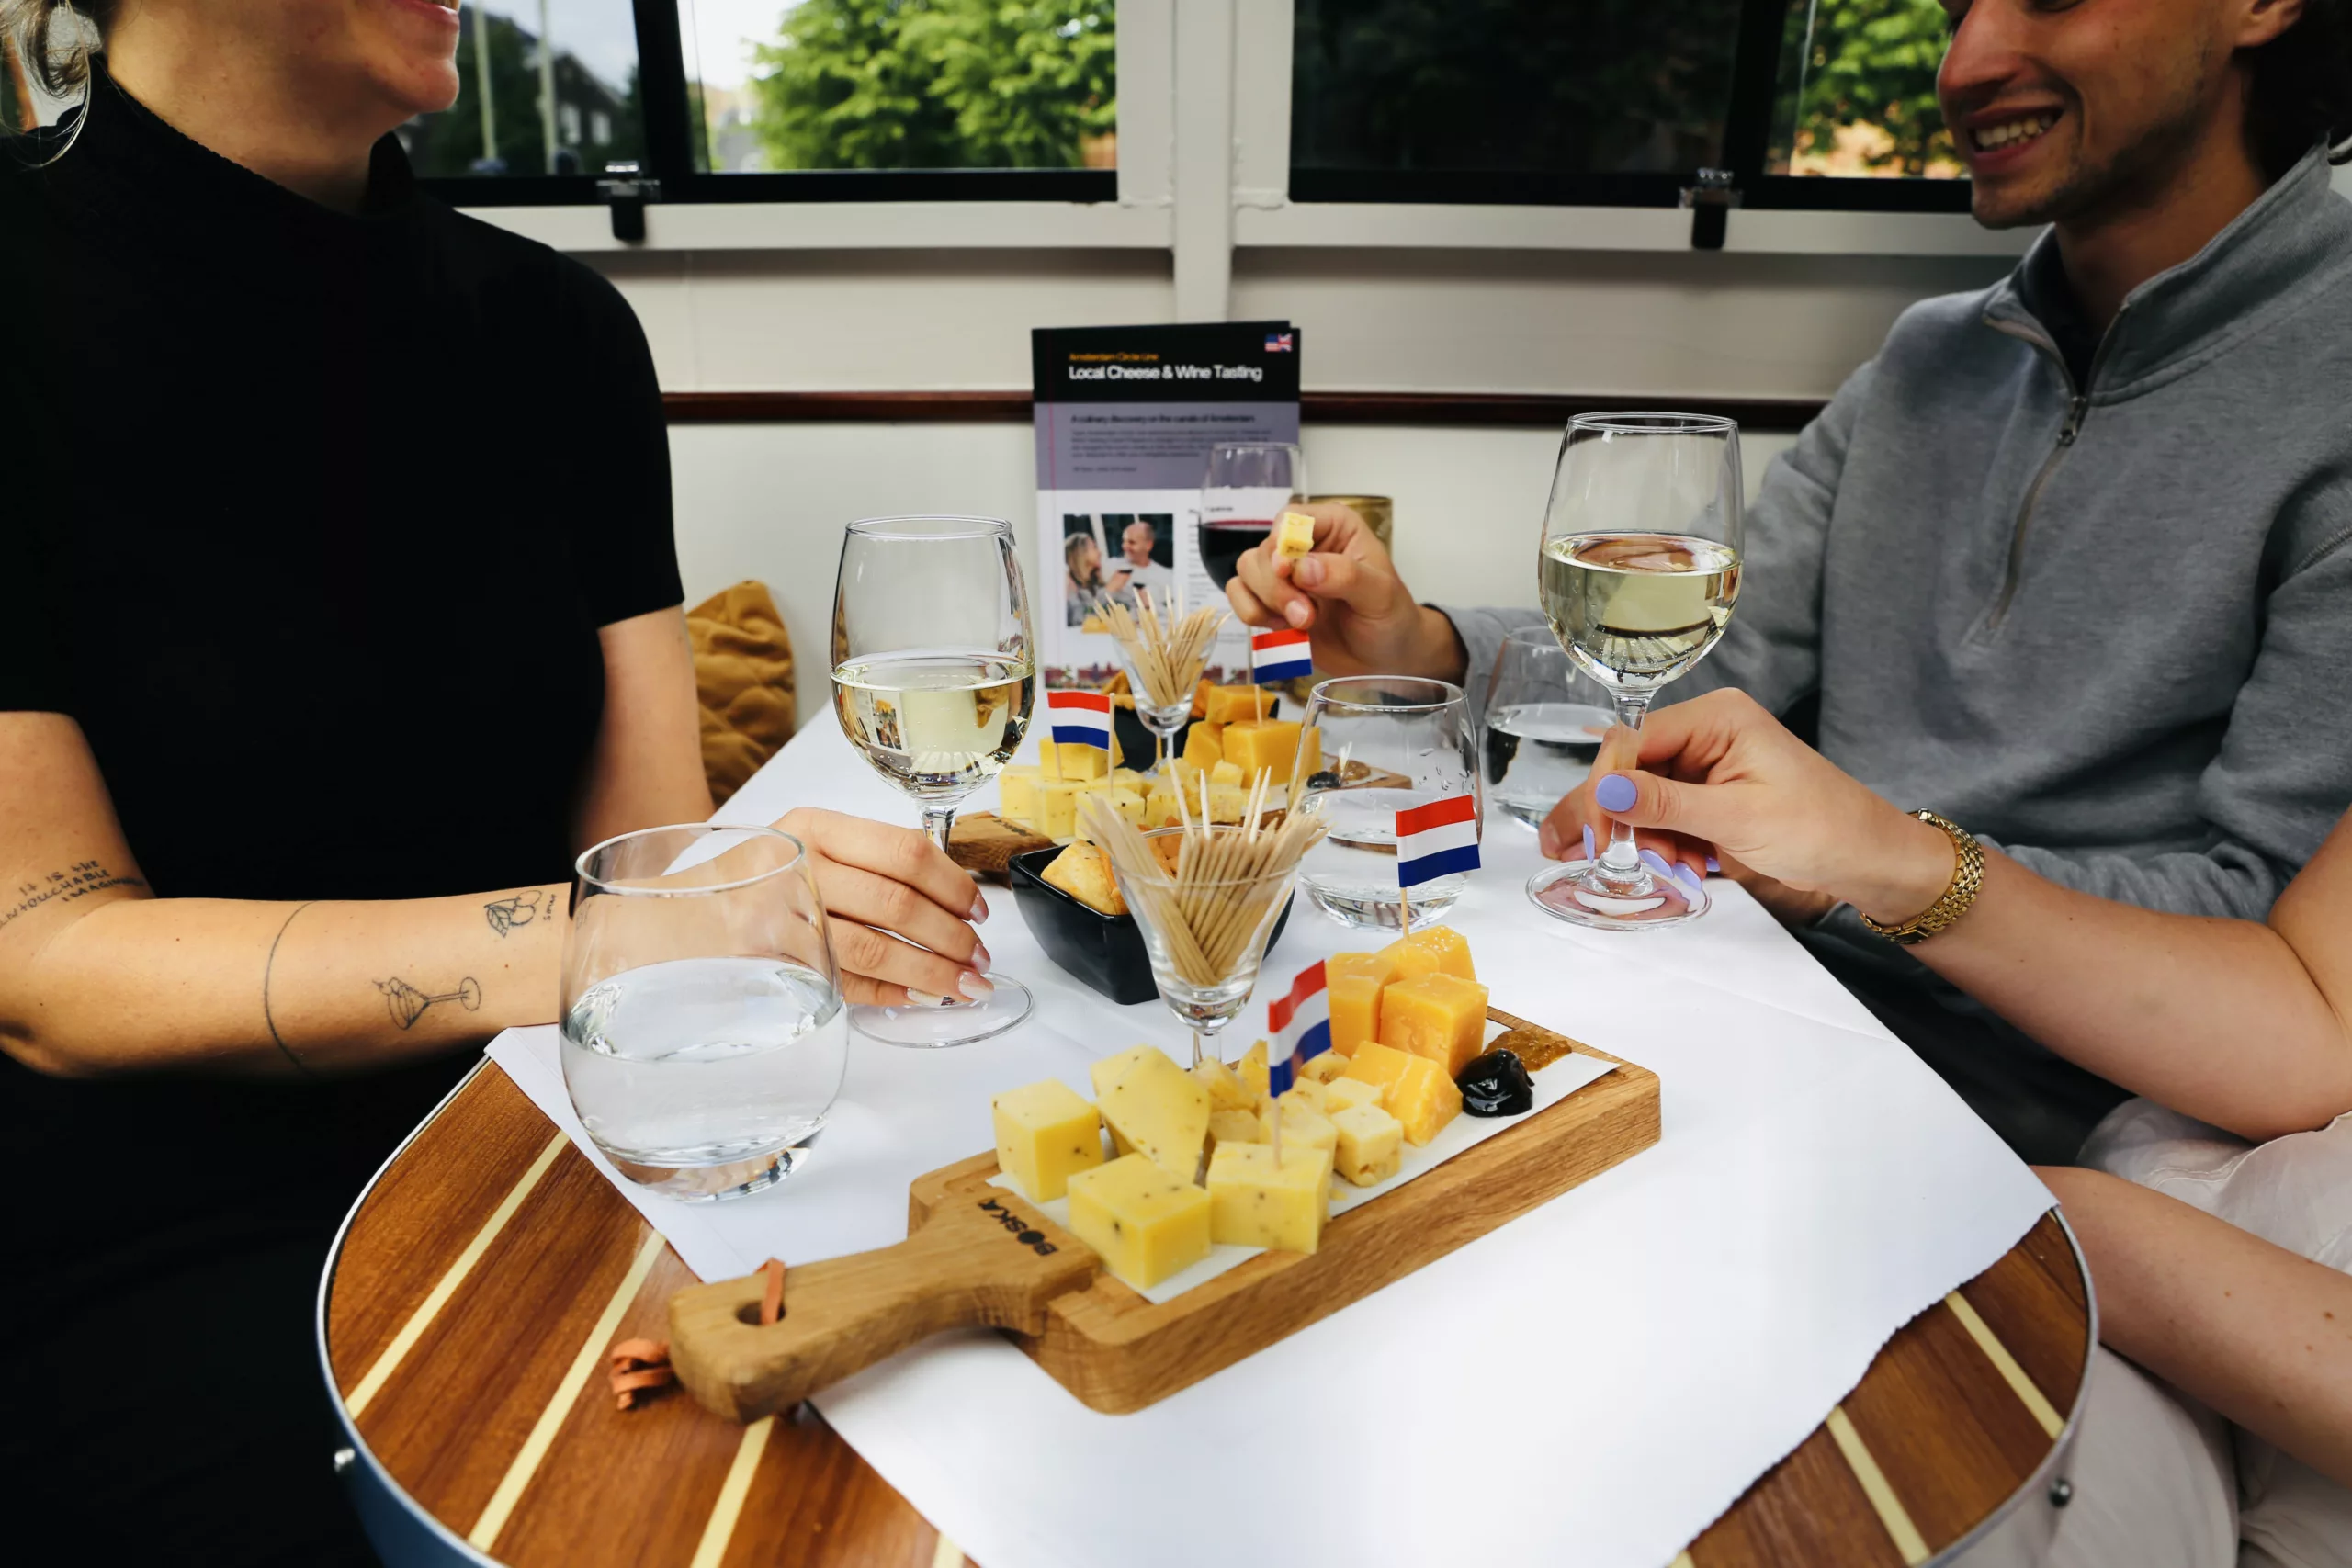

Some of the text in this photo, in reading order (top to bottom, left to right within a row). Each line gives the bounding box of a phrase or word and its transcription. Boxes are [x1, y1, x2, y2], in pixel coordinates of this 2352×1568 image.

[1069, 364, 1263, 382] Local Cheese & Wine Tasting
[977, 1198, 1059, 1257] BOSKA
